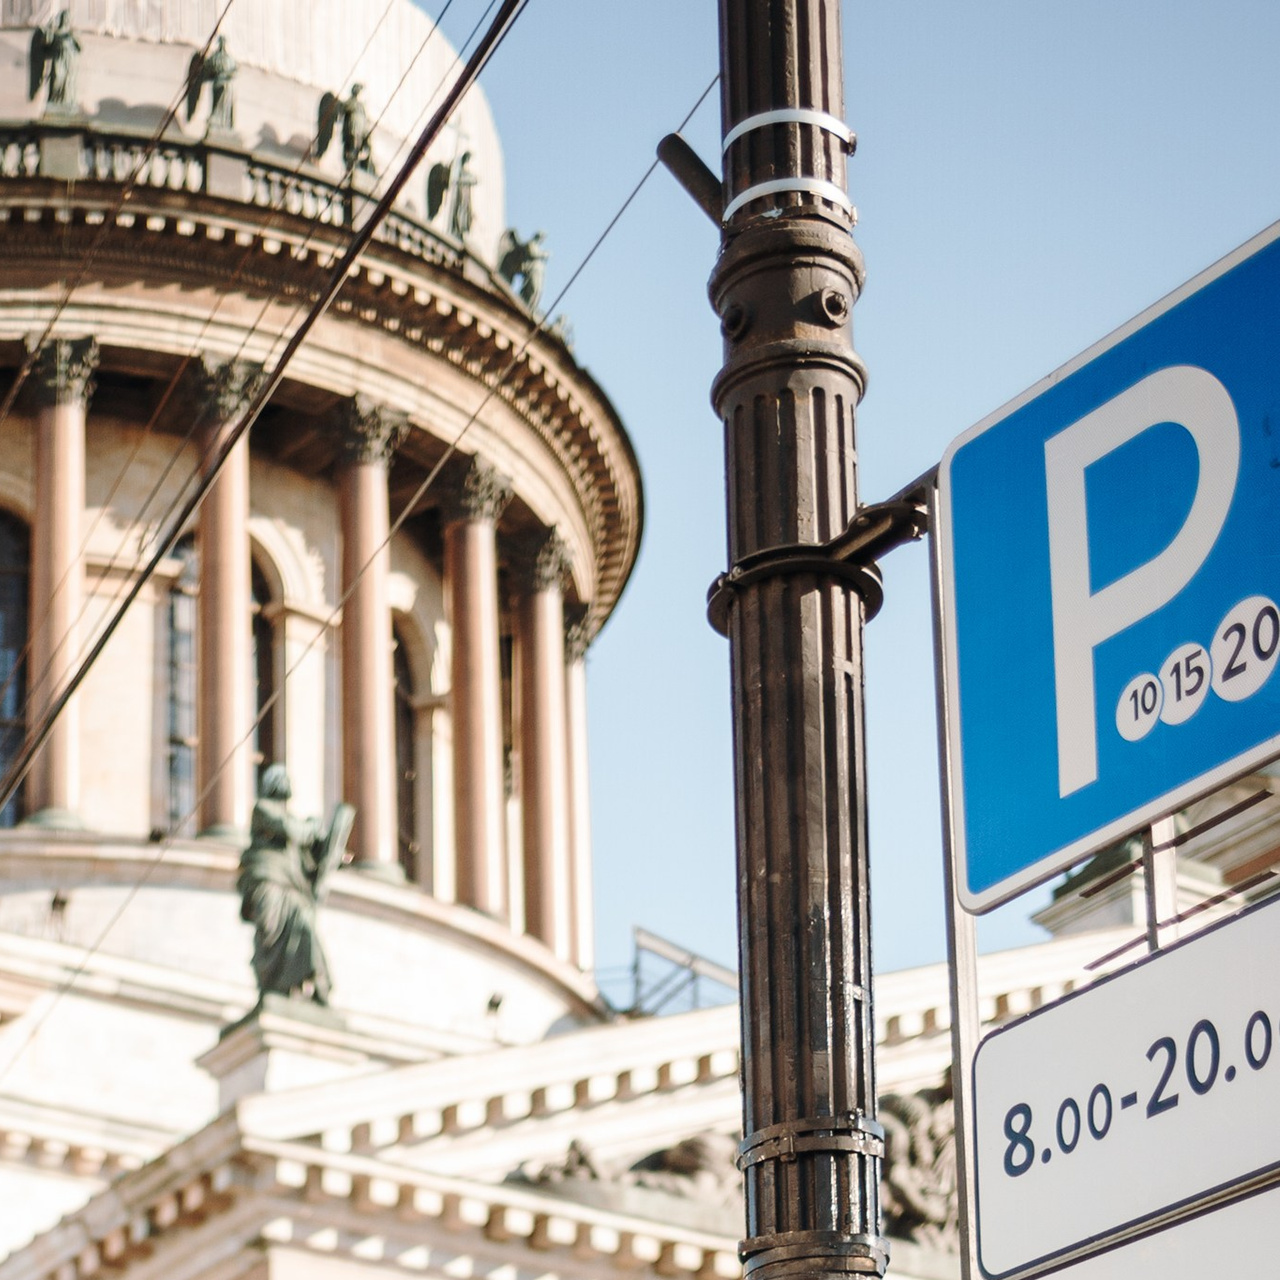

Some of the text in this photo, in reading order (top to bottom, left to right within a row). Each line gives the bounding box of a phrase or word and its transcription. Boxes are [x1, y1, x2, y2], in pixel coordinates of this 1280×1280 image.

[1044, 364, 1240, 799] P
[1129, 605, 1280, 721] 10 15 20
[1004, 1010, 1280, 1177] 8.00-20.0
